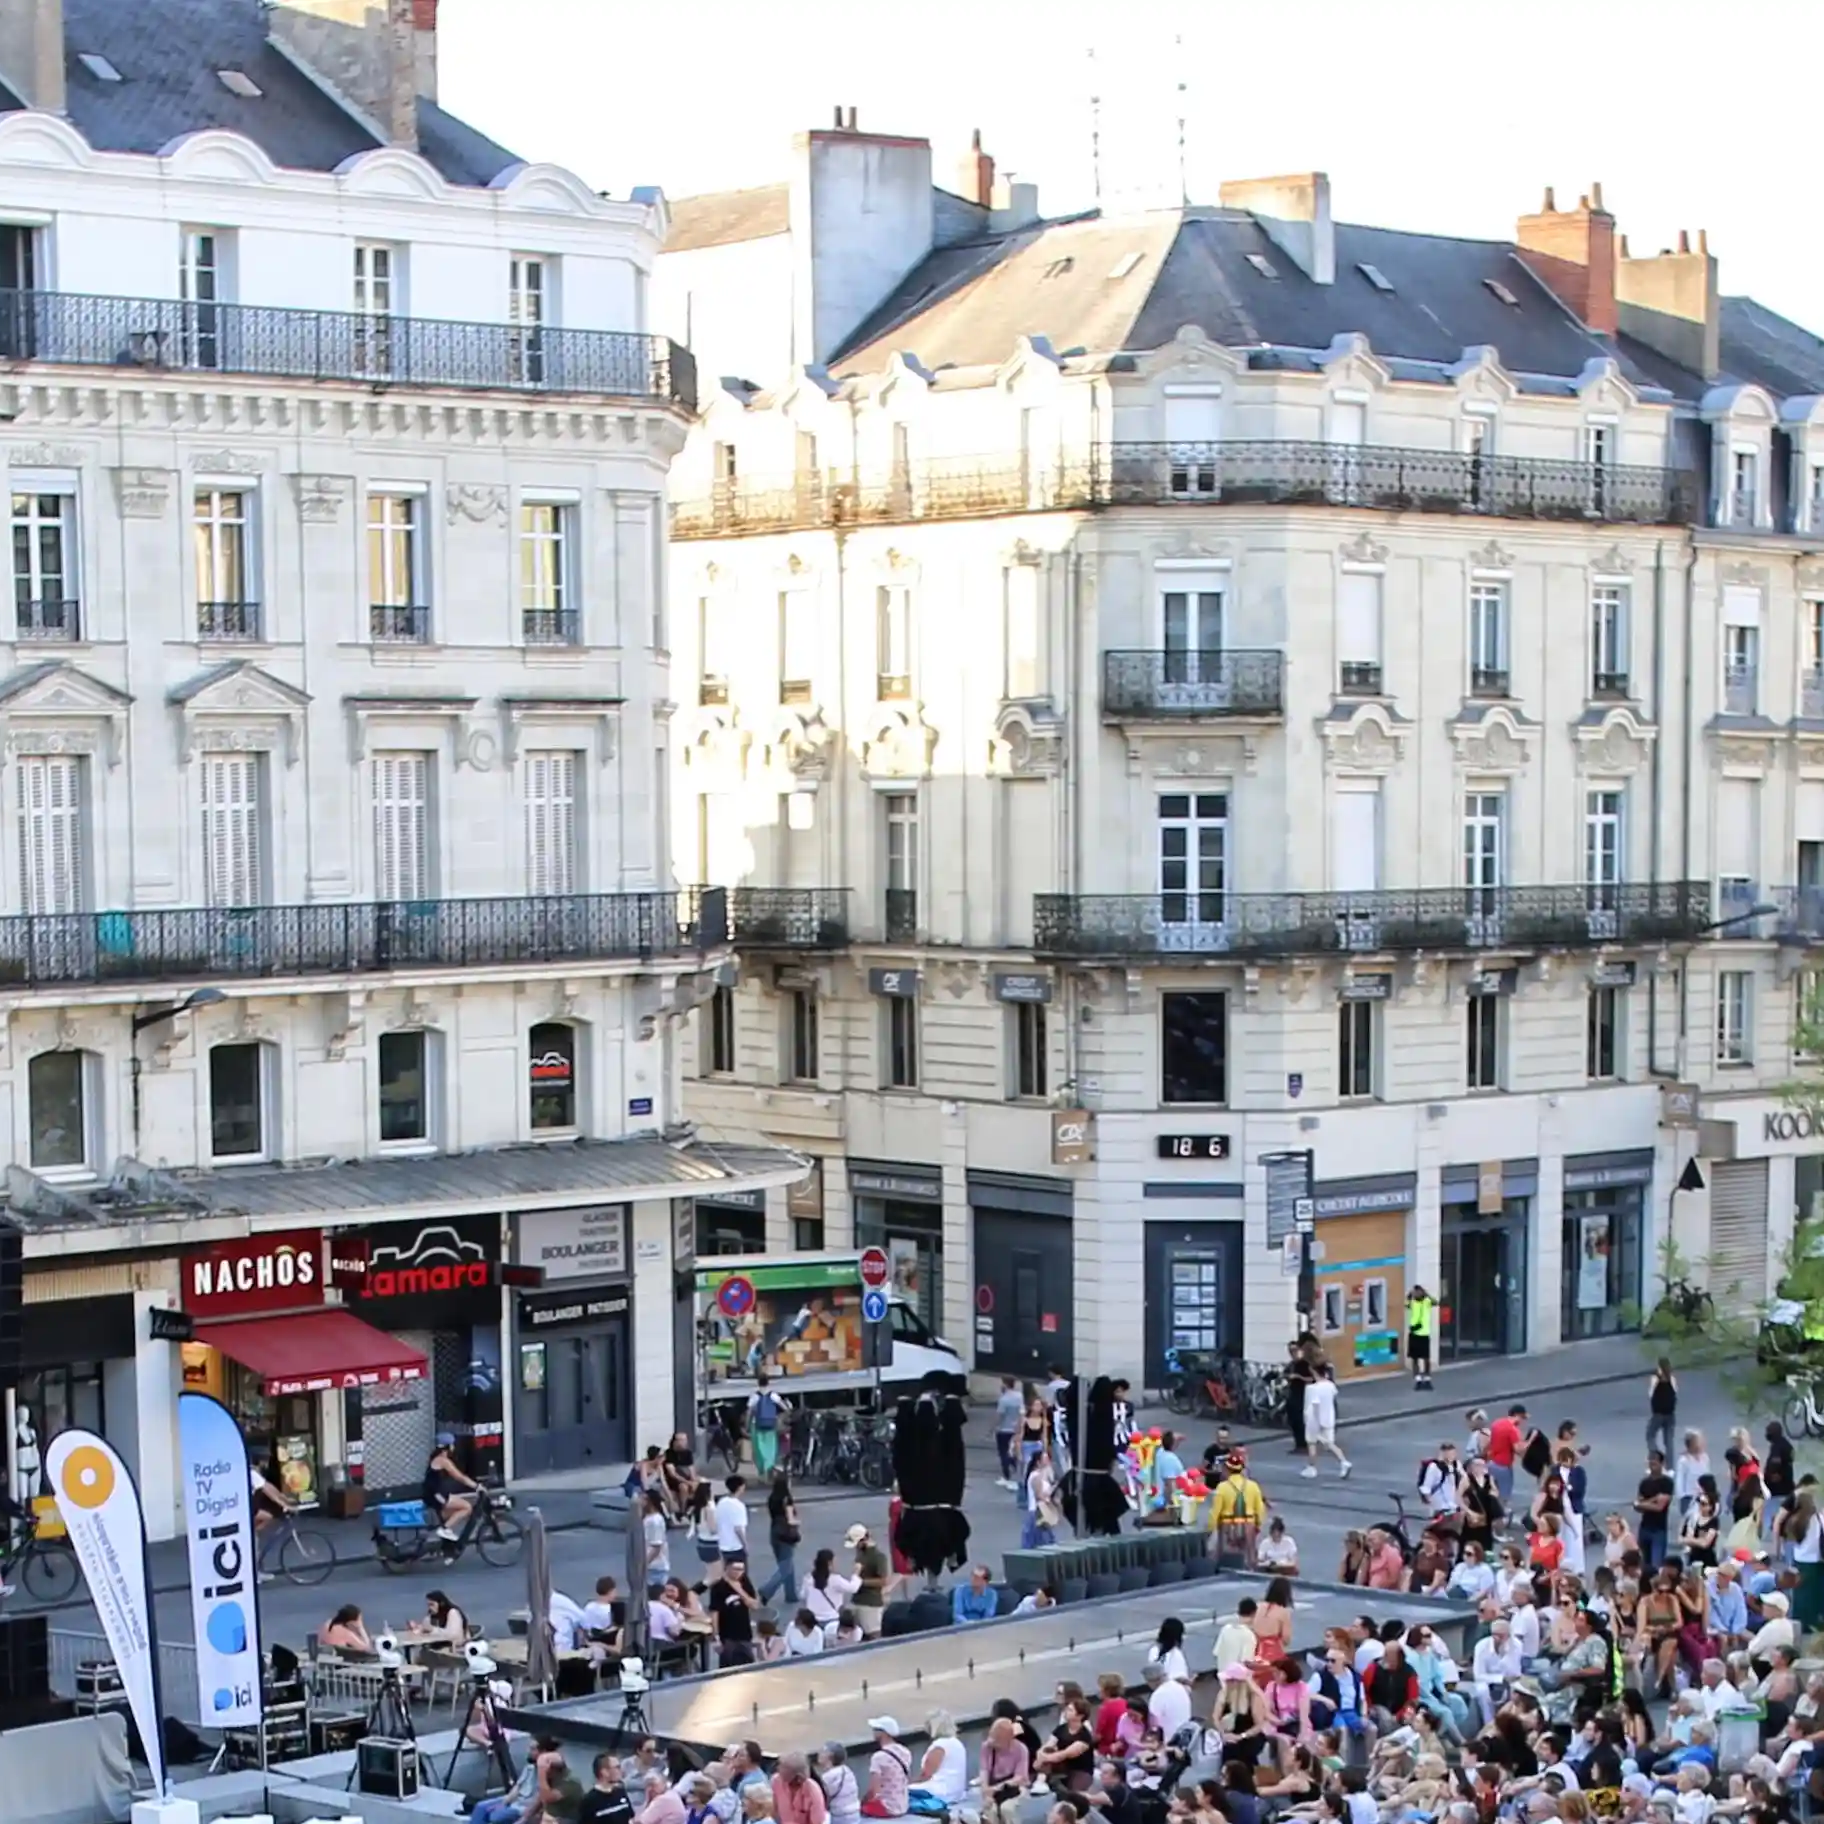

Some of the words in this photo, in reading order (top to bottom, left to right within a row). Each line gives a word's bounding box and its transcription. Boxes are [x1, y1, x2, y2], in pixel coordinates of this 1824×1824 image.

[541, 1240, 619, 1260] BOULANGER
[194, 1250, 314, 1296] NACHOS
[863, 1259, 885, 1274] STOP
[361, 1262, 489, 1298] amara
[533, 1305, 583, 1324] BOULANGER
[193, 1459, 231, 1479] Radio
[195, 1478, 213, 1496] TV
[195, 1493, 239, 1517] Digital
[198, 1522, 244, 1599] ici
[234, 1685, 252, 1709] ici
